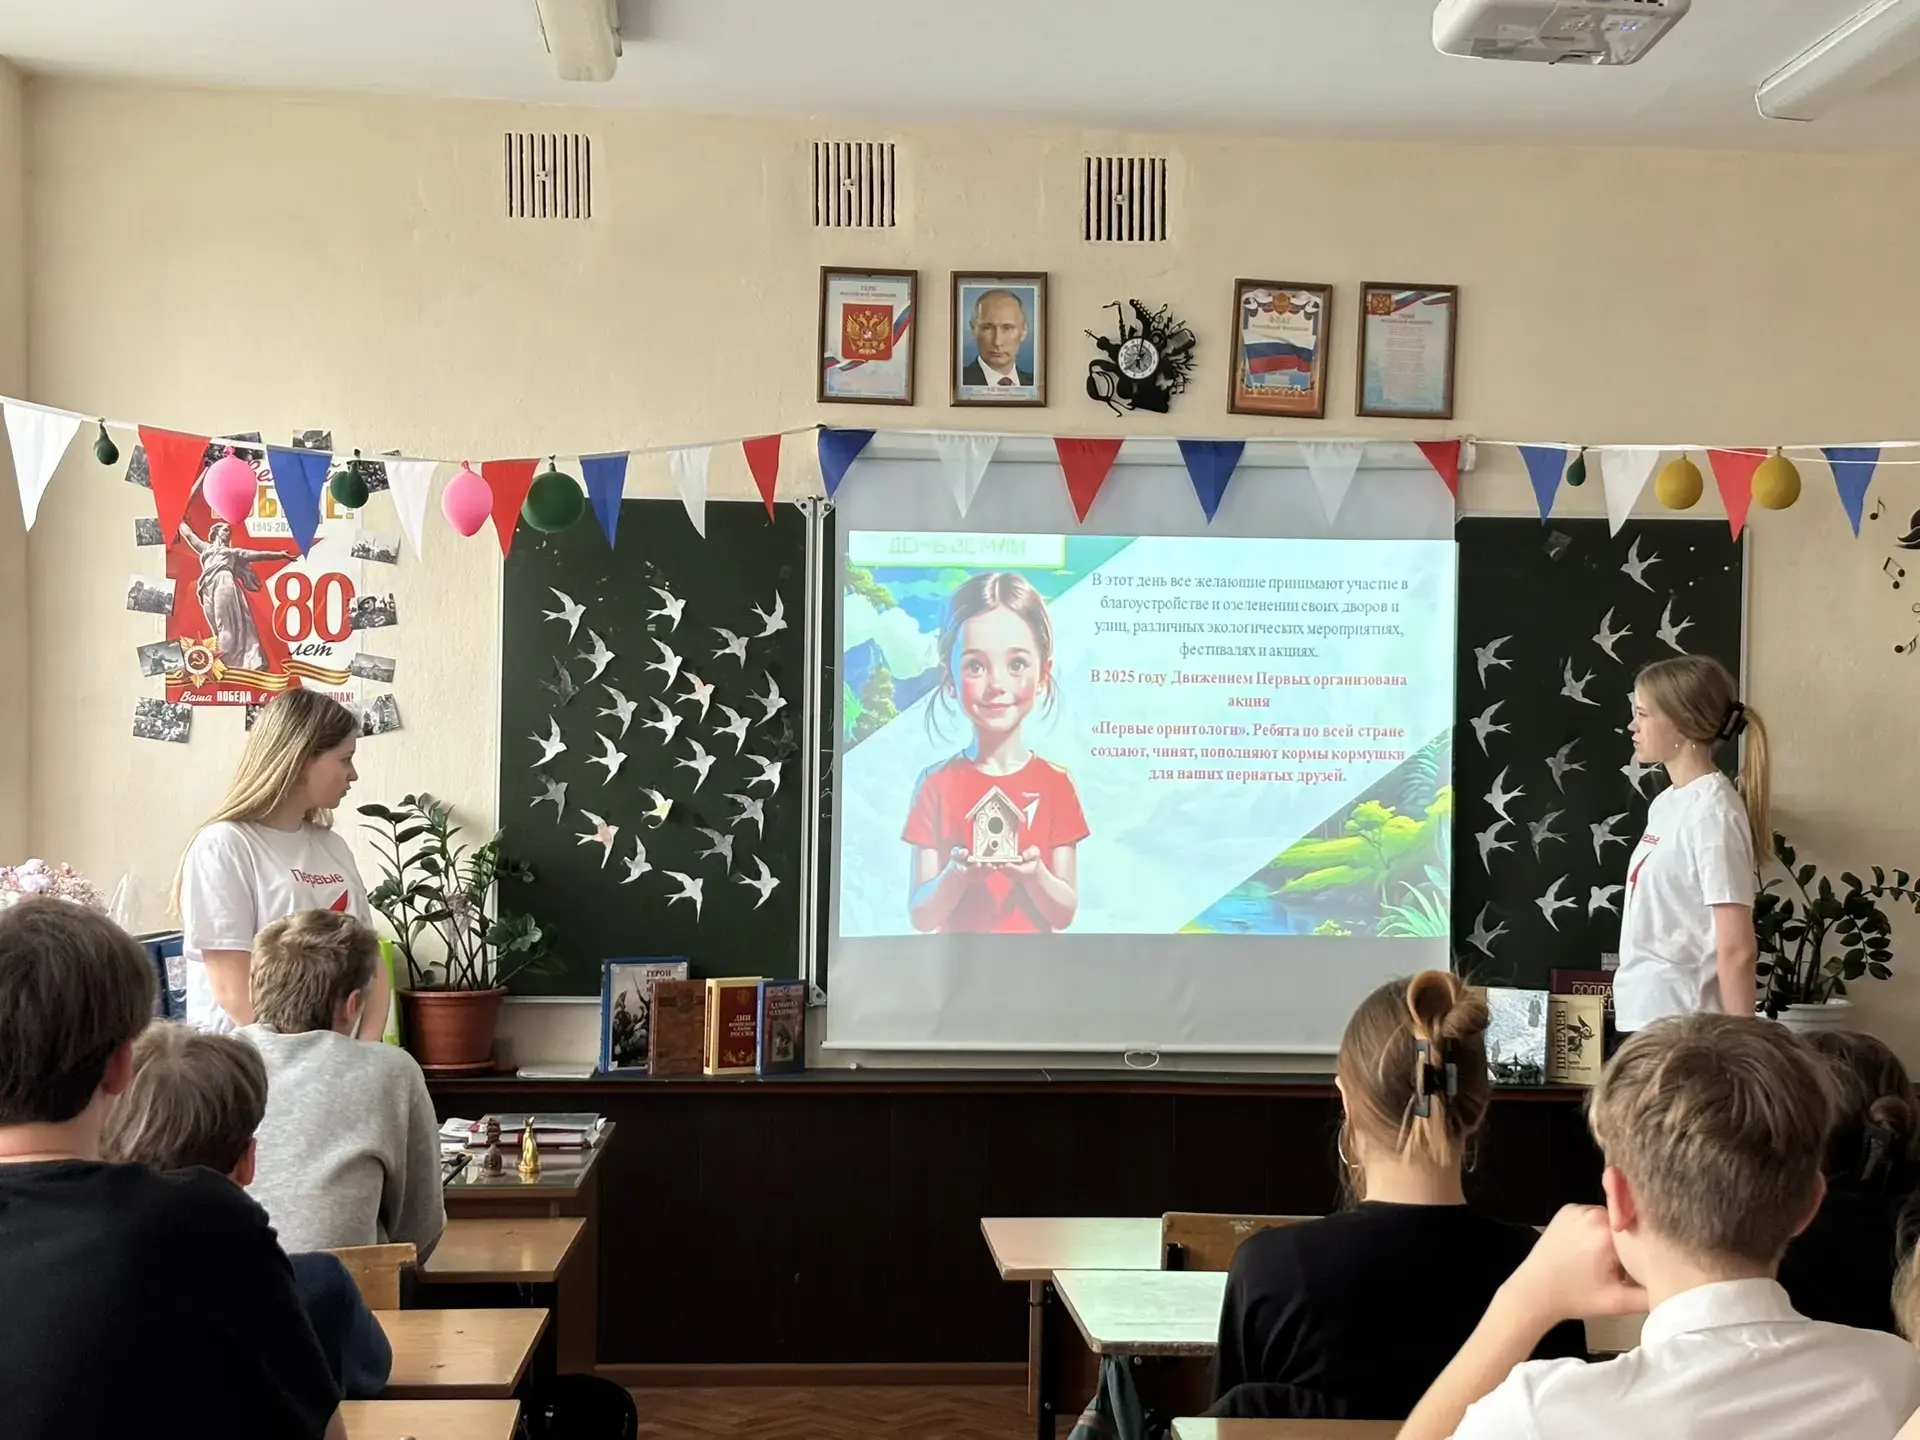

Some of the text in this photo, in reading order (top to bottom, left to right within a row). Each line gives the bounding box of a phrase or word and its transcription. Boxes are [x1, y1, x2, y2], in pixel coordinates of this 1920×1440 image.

[1092, 573, 1408, 594] В этот день все желающие принимают участие в
[272, 572, 355, 642] 80
[1100, 596, 1399, 616] благоустройстве и озеленении своих дворов и
[1094, 620, 1404, 639] улиц, различных экологических мероприятиях,
[289, 640, 335, 657] лет
[1179, 642, 1318, 659] фестивалях и акциях.
[1090, 669, 1407, 689] В 2025 году Движением Первых организована
[180, 690, 213, 702] Ваша
[217, 690, 252, 703] ПОБЕДА
[1227, 696, 1270, 708] акция
[1091, 721, 1404, 740] «Первые орнитологи». Ребята по всей стране
[1090, 746, 1405, 764] создают, чинят, пополняют кормы кормушки
[1149, 768, 1347, 785] для наших пернатых друзей.
[290, 868, 344, 888] Первые
